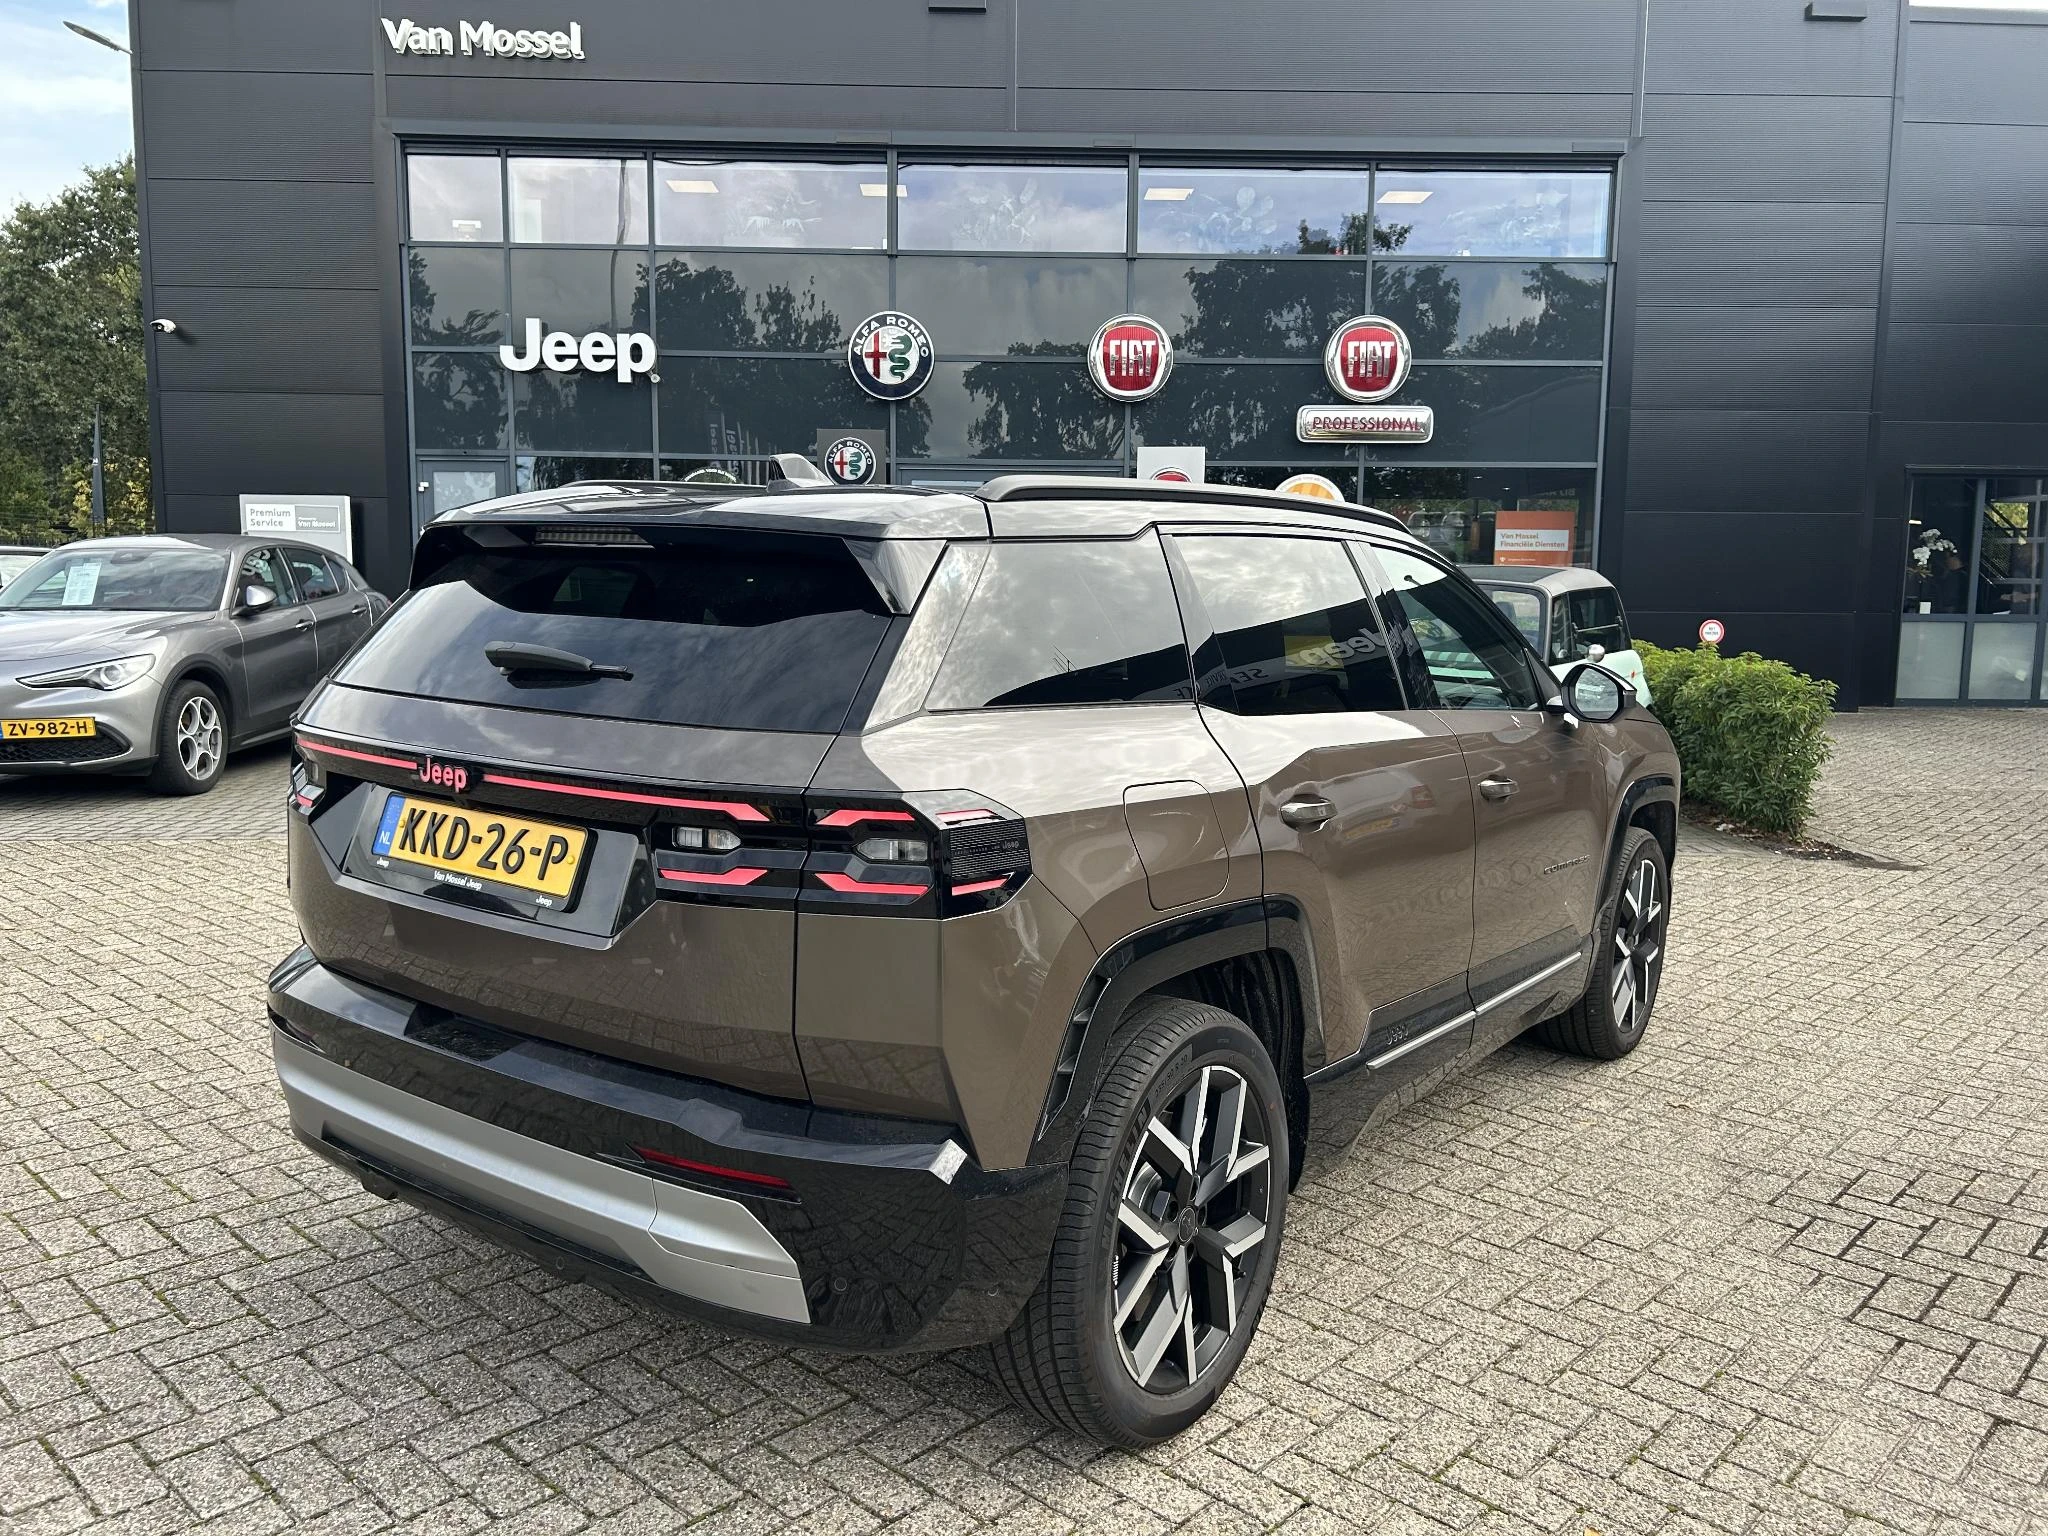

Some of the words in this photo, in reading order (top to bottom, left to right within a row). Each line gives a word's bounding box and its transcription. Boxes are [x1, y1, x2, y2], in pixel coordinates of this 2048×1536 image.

[381, 18, 453, 55] Van
[459, 20, 585, 60] Mossel
[853, 320, 881, 356] ALFA
[886, 316, 929, 357] ROMEO
[500, 318, 656, 383] Jeep
[1109, 340, 1156, 376] FIAT
[1347, 341, 1394, 377] FIAT
[1312, 416, 1421, 431] PROFESSIONAL
[827, 442, 844, 464] ALFA
[846, 441, 872, 465] ROMEO
[250, 508, 291, 517] Premium
[250, 518, 284, 527] Service
[8, 721, 88, 736] ZV-982-H
[419, 755, 467, 793] Jeep
[379, 830, 391, 845] NL
[398, 807, 569, 881] KKD-26-P
[376, 857, 390, 868] Jeep
[434, 870, 444, 881] Van
[444, 873, 467, 886] Mossel
[467, 880, 482, 891] Jeep
[535, 895, 553, 907] Jeep
[1101, 1097, 1151, 1250] MICHELIN
